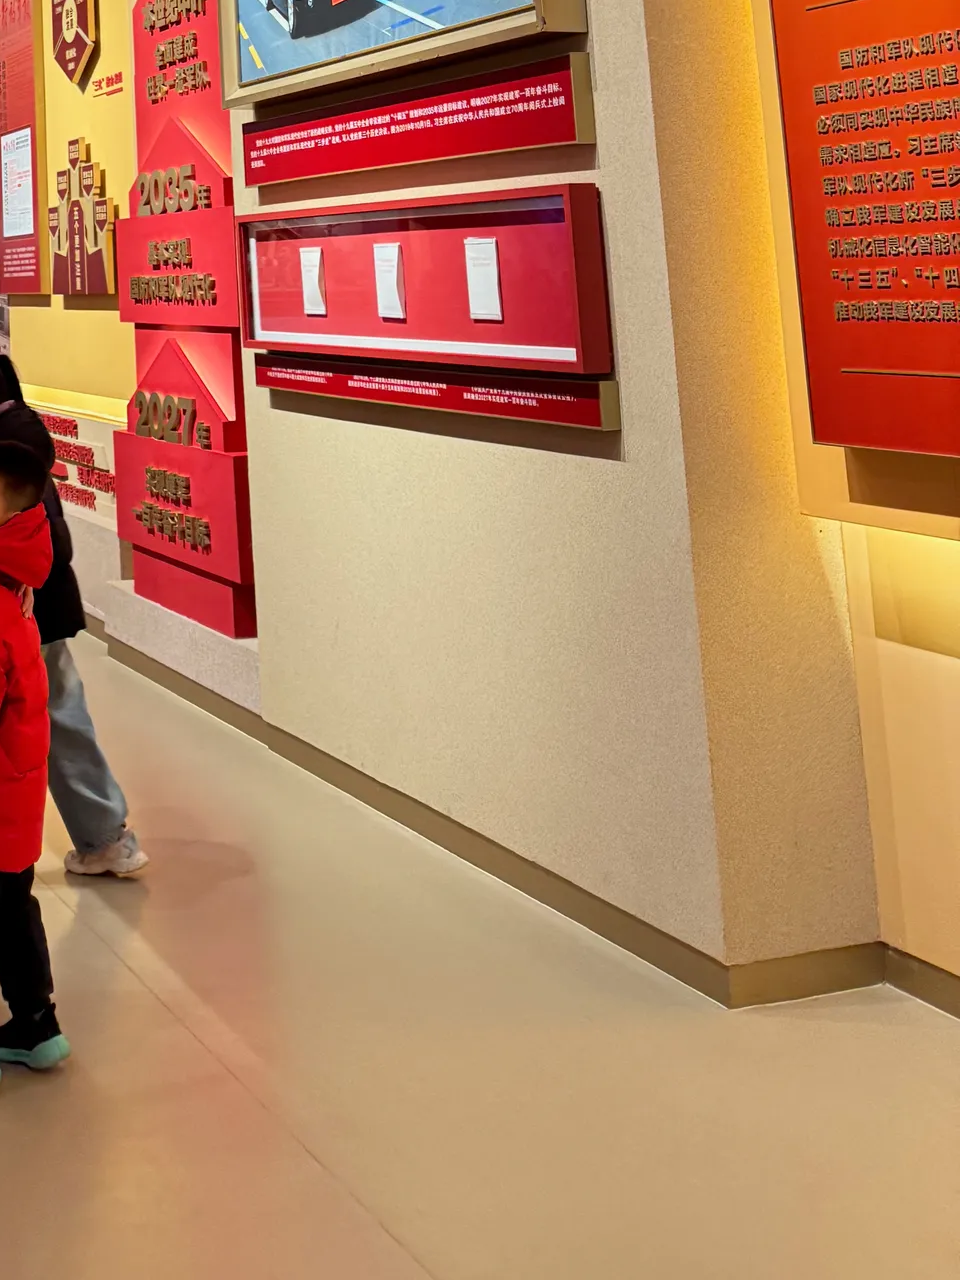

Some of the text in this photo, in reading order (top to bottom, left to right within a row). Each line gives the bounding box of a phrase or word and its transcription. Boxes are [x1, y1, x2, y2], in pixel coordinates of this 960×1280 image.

[155, 31, 198, 69] 全面建成
[137, 164, 211, 217] 2035年
[825, 199, 960, 227] 确立我军建设发展
[148, 238, 192, 270] 基本实现
[130, 272, 216, 305] 国防和军队现代化
[834, 299, 960, 323] 推动我军建设发展
[135, 391, 212, 450] 2027年
[132, 501, 212, 556] 一百年奋斗目标
